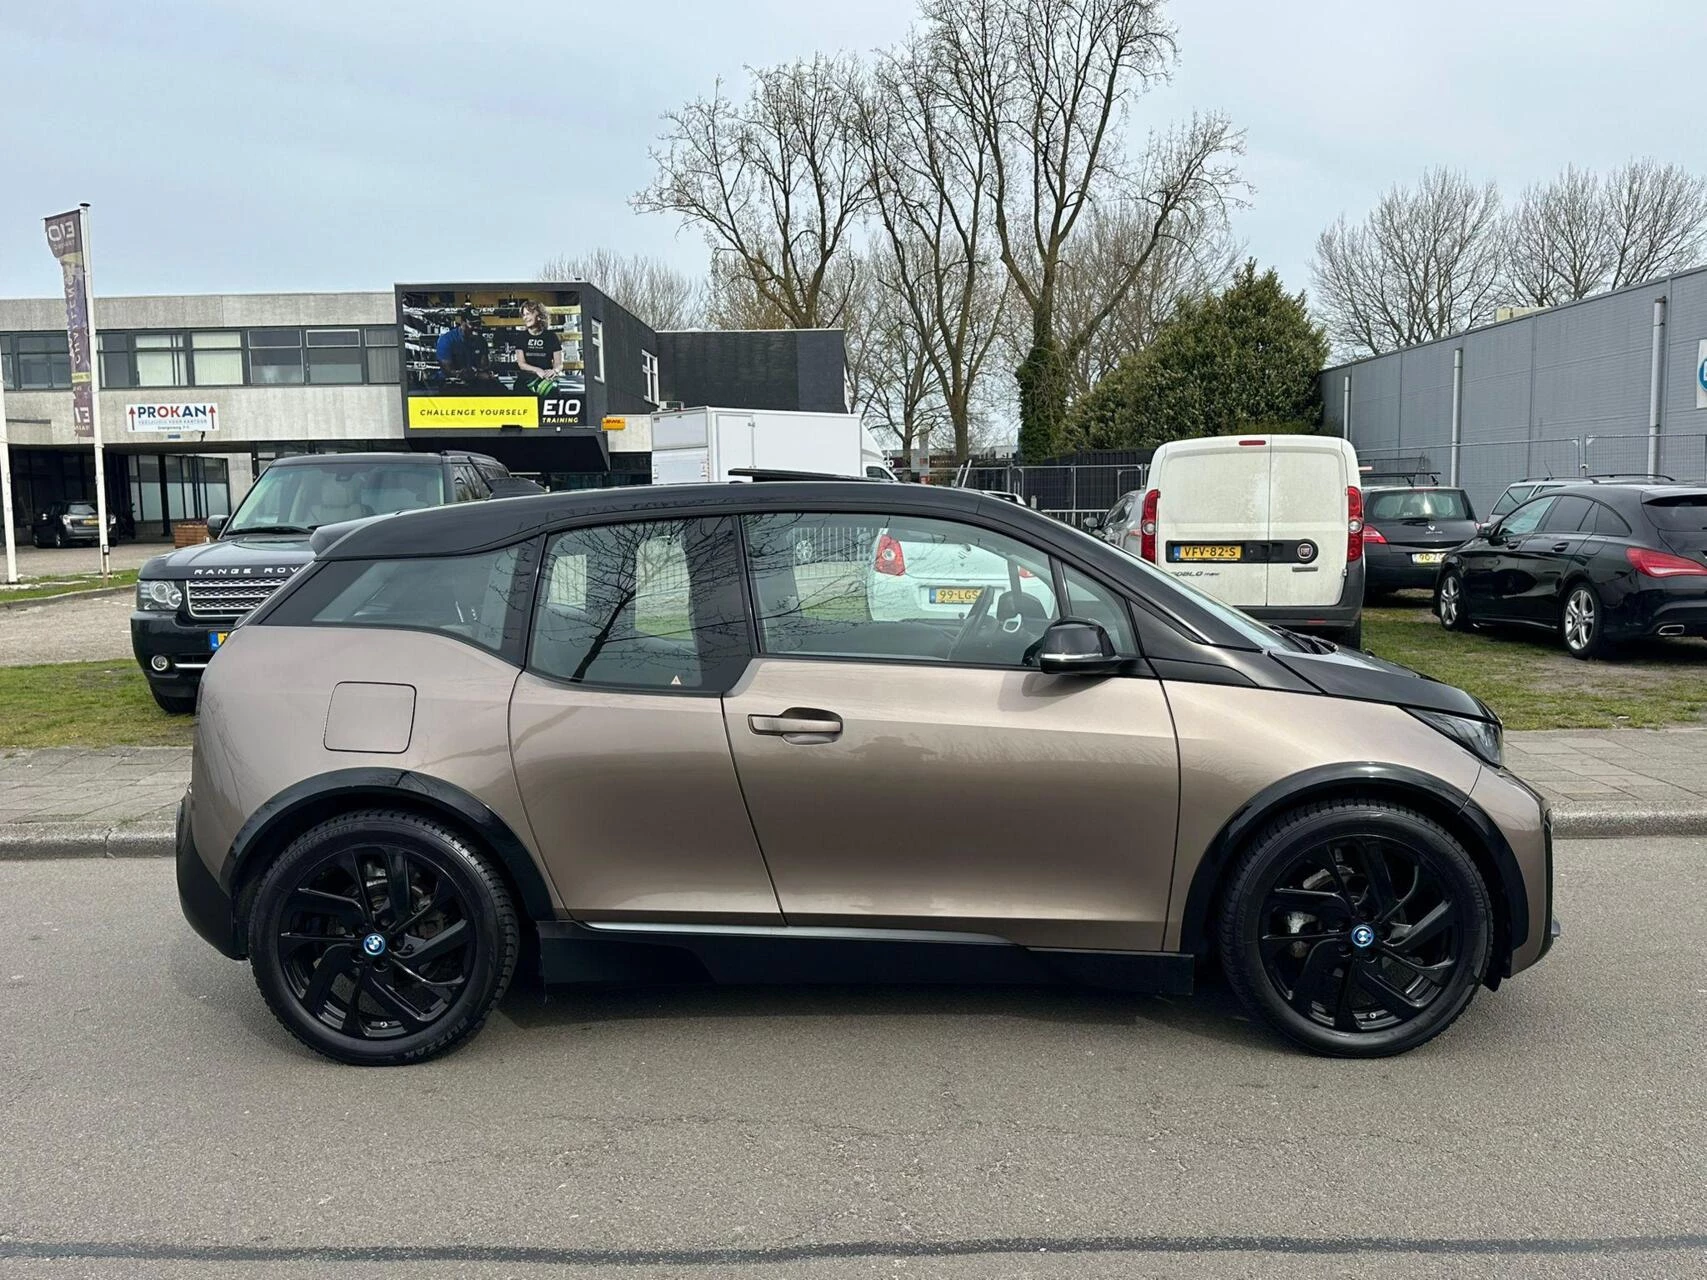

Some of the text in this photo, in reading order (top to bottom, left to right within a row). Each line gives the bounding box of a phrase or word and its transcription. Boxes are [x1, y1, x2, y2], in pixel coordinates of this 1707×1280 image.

[527, 339, 544, 347] E10
[138, 405, 207, 418] PROKAN
[542, 399, 581, 416] E10
[1184, 546, 1236, 557] VFV-82-S
